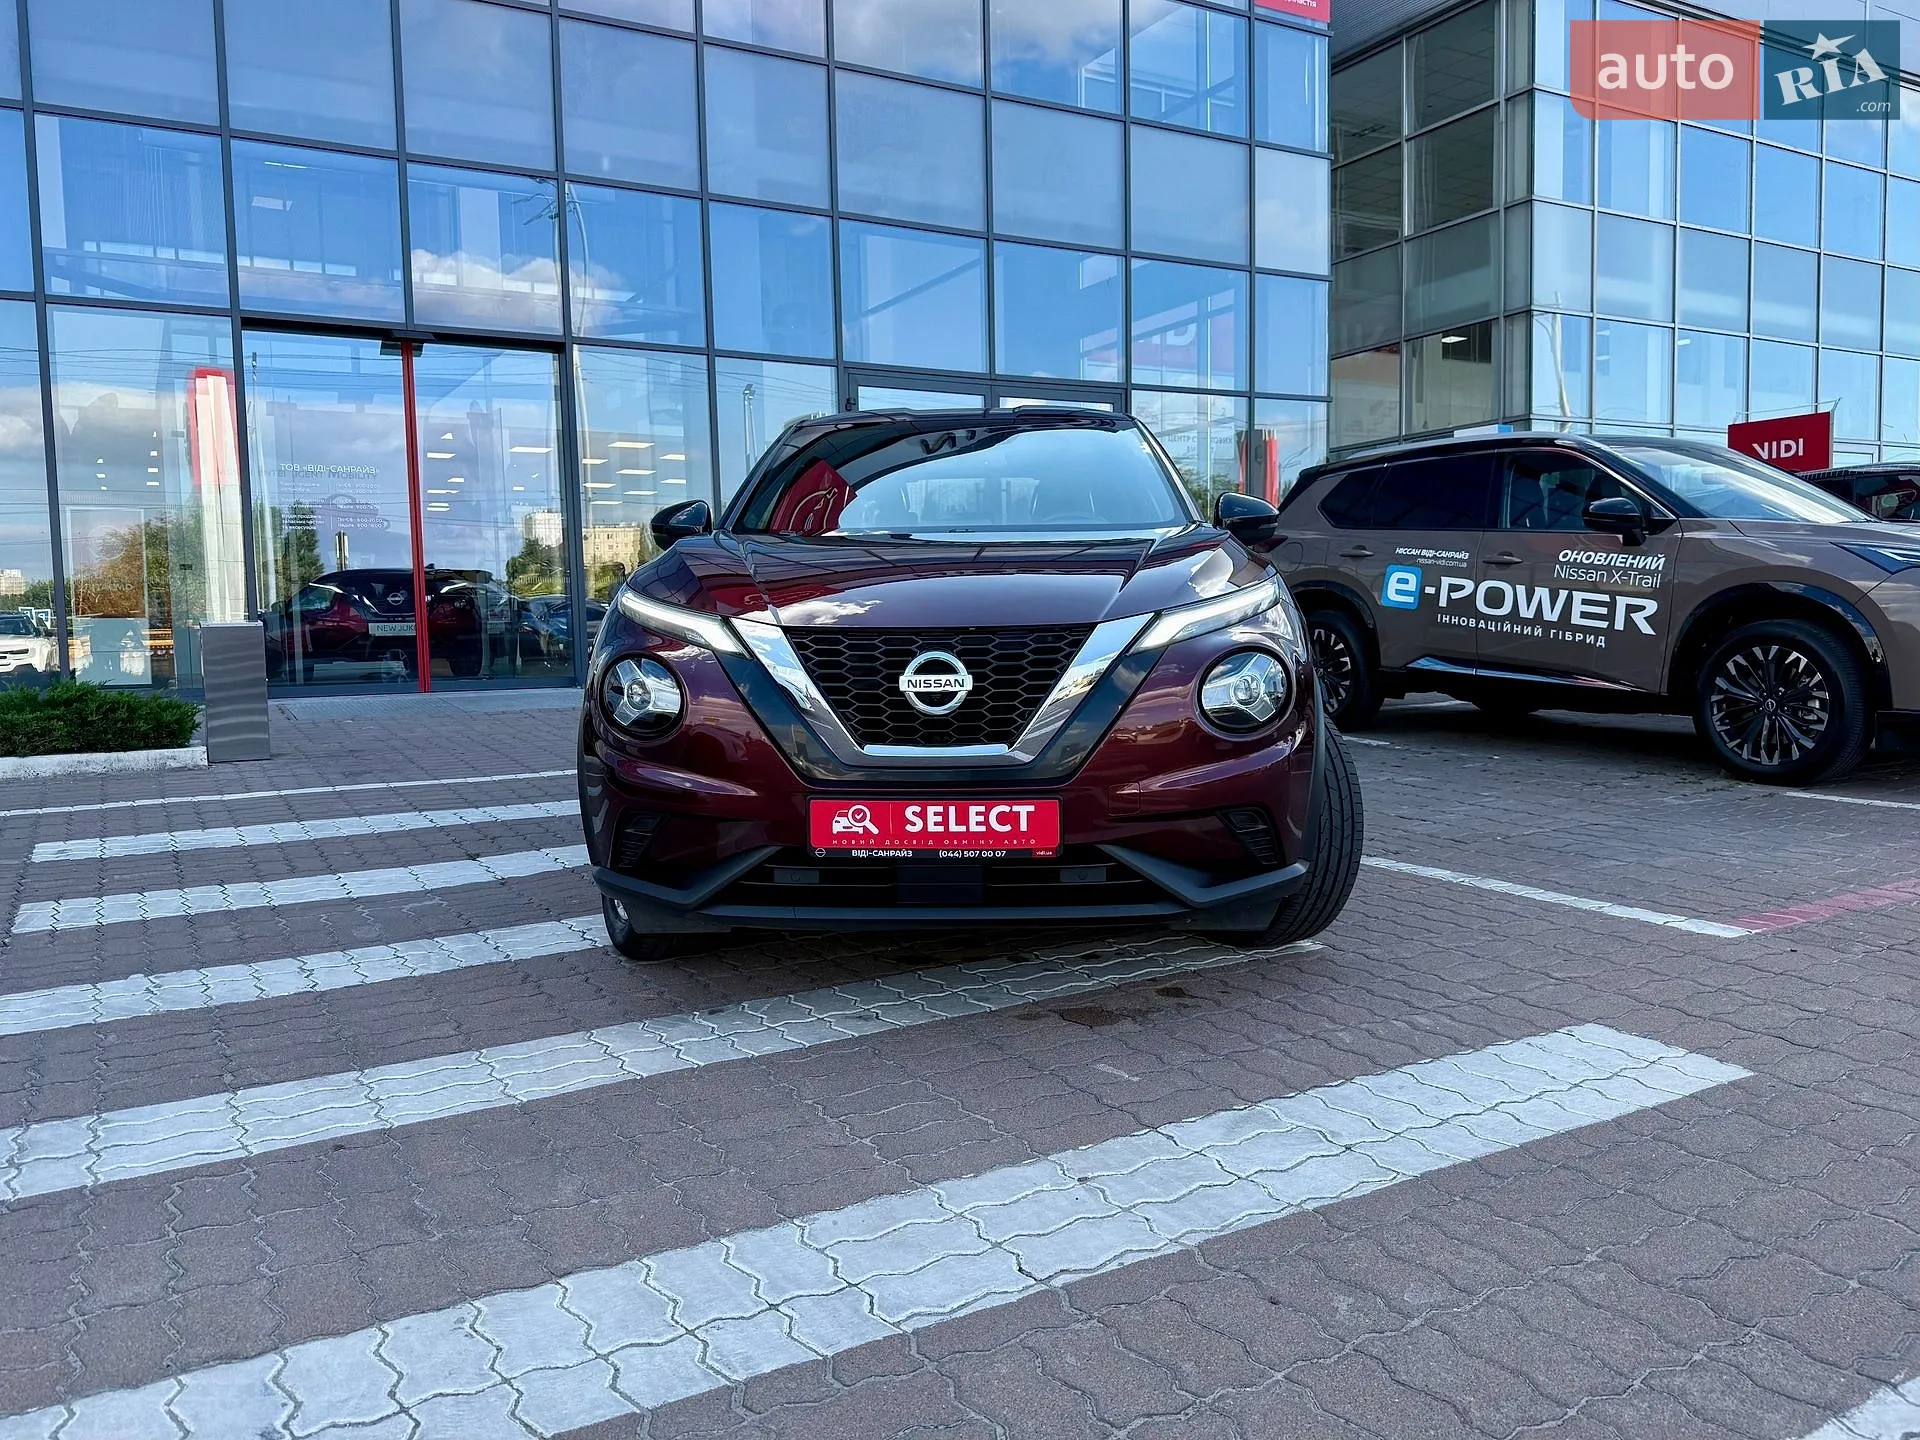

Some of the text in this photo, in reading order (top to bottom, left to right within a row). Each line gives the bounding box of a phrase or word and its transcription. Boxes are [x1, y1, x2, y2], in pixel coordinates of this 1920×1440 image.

[1752, 438, 1804, 460] VIDI
[280, 463, 300, 471] ТОВ
[1395, 547, 1422, 556] НІССАН
[1558, 550, 1666, 571] ОНОВЛЕНИЙ
[1416, 557, 1467, 568] nissan-vidi.com.ua
[1554, 564, 1661, 588] Nissan X-Trail
[1386, 570, 1658, 636] e-POWER
[1437, 613, 1606, 649] ІННОВАЦІЙНИЙ ГІБРИД
[907, 678, 965, 689] NISSAN
[904, 804, 1036, 833] SELECT
[851, 849, 913, 858] ВІДІ-САНРАЙЗ
[938, 850, 962, 858] (044)
[963, 850, 980, 858] 507
